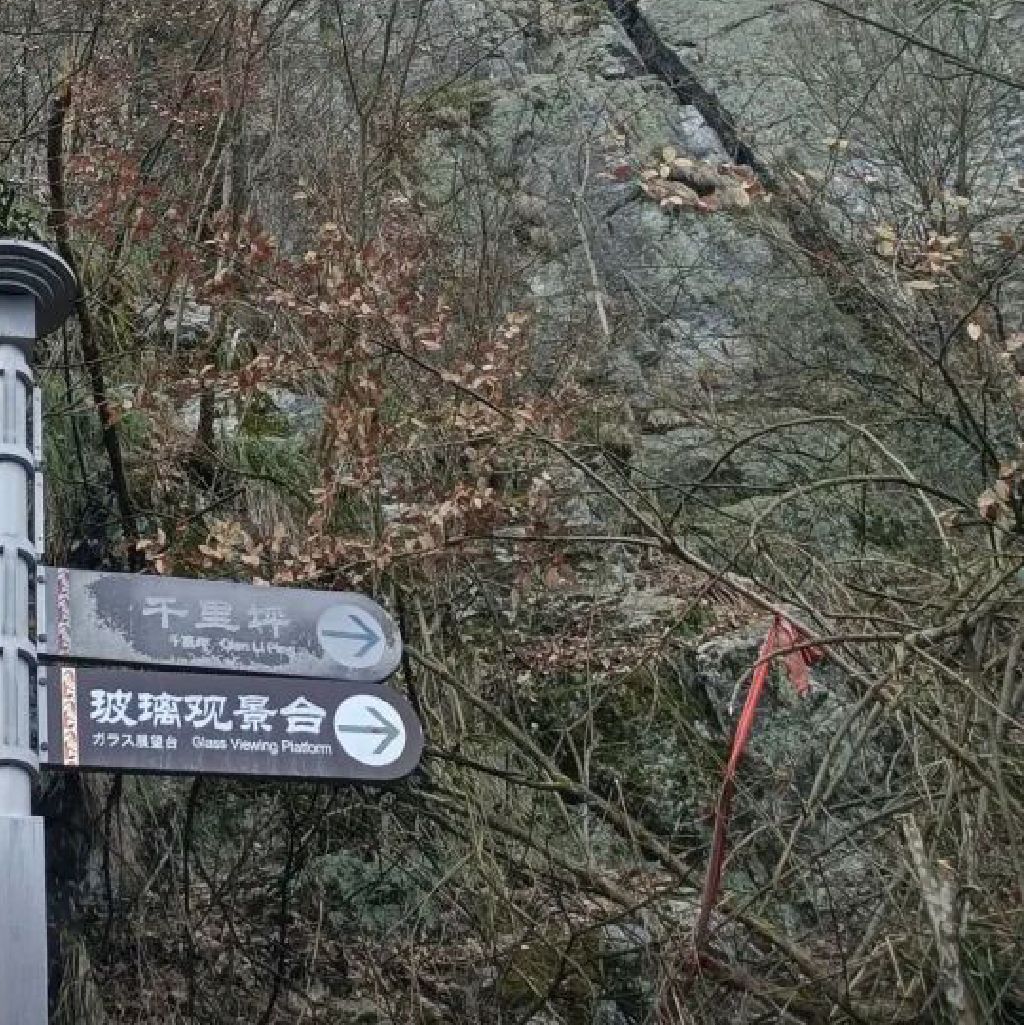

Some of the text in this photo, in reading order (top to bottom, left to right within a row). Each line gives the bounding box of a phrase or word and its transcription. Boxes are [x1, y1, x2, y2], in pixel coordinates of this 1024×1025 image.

[192, 736, 333, 756] Glass Viewing Platform
